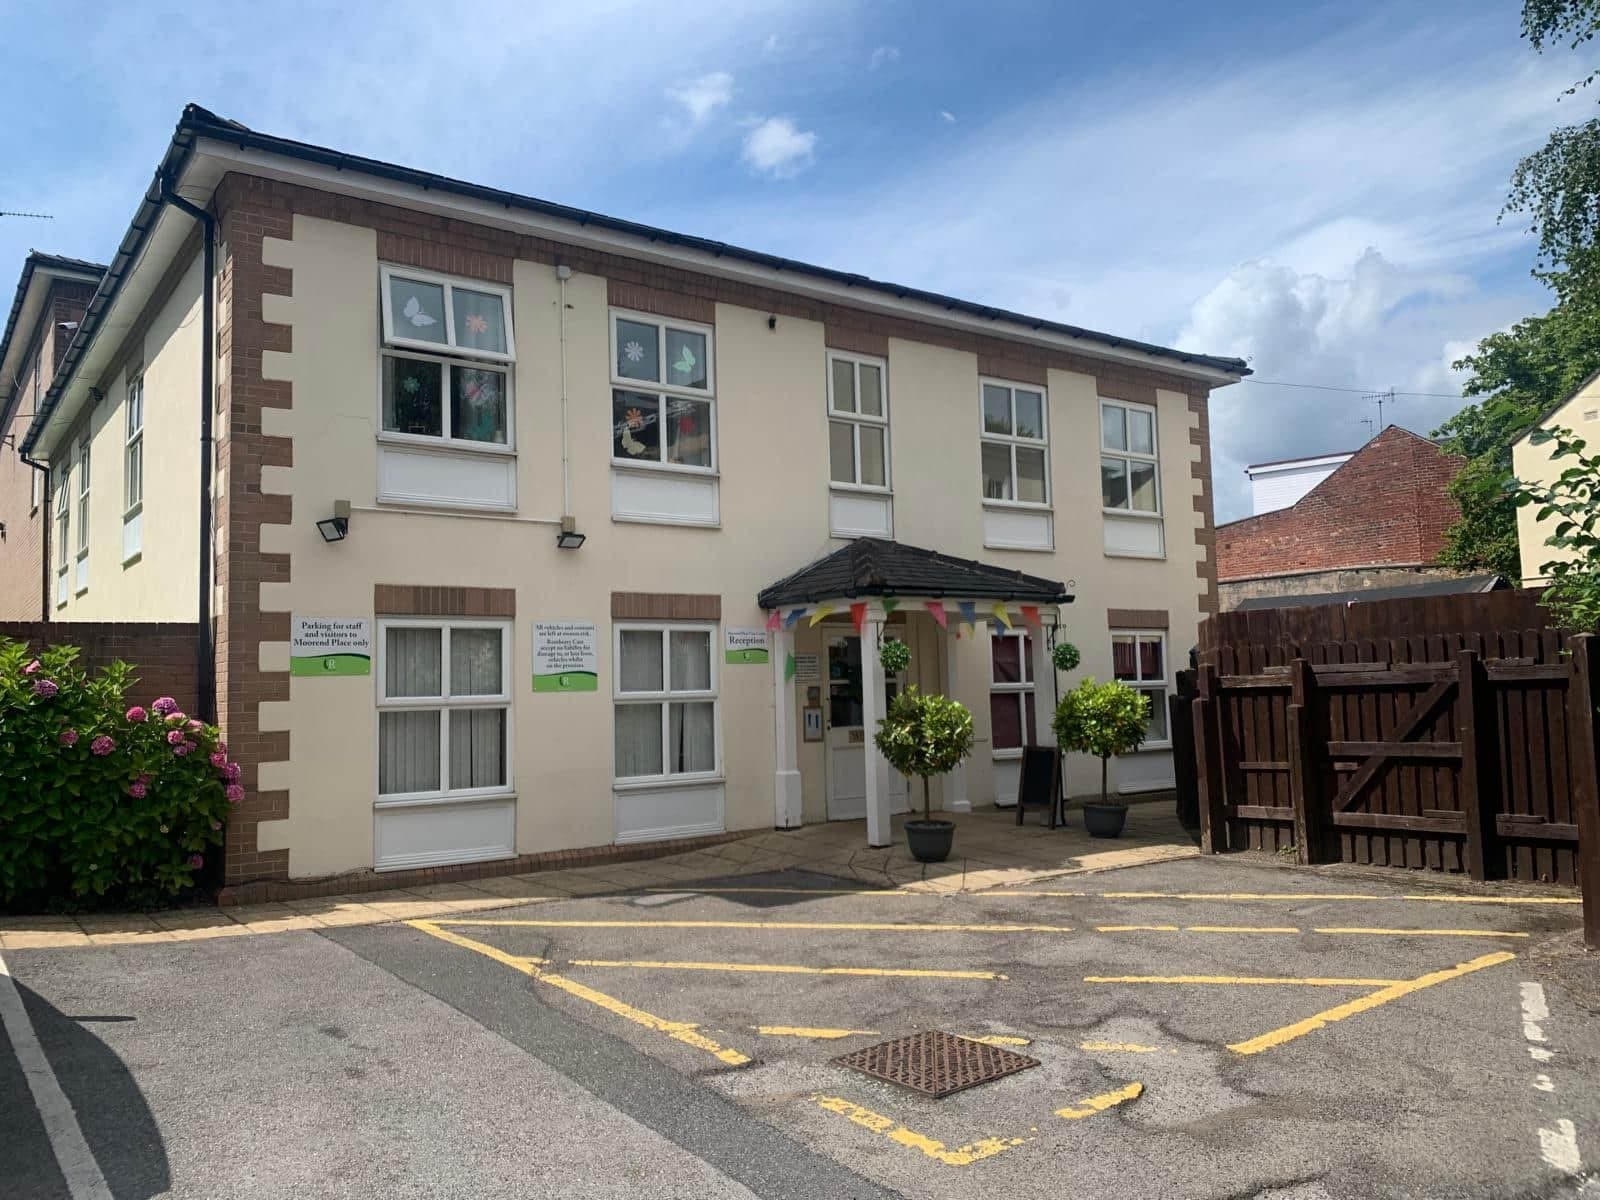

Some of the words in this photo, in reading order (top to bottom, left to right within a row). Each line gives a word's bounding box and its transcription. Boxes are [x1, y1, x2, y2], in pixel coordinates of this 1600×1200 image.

[302, 621, 331, 631] Parking
[333, 622, 344, 630] for
[345, 621, 362, 630] staff
[304, 630, 319, 638] and
[320, 630, 348, 638] visitors
[293, 638, 330, 647] Moorend
[331, 638, 352, 647] Place
[352, 639, 369, 648] only
[729, 635, 765, 647] Reception
